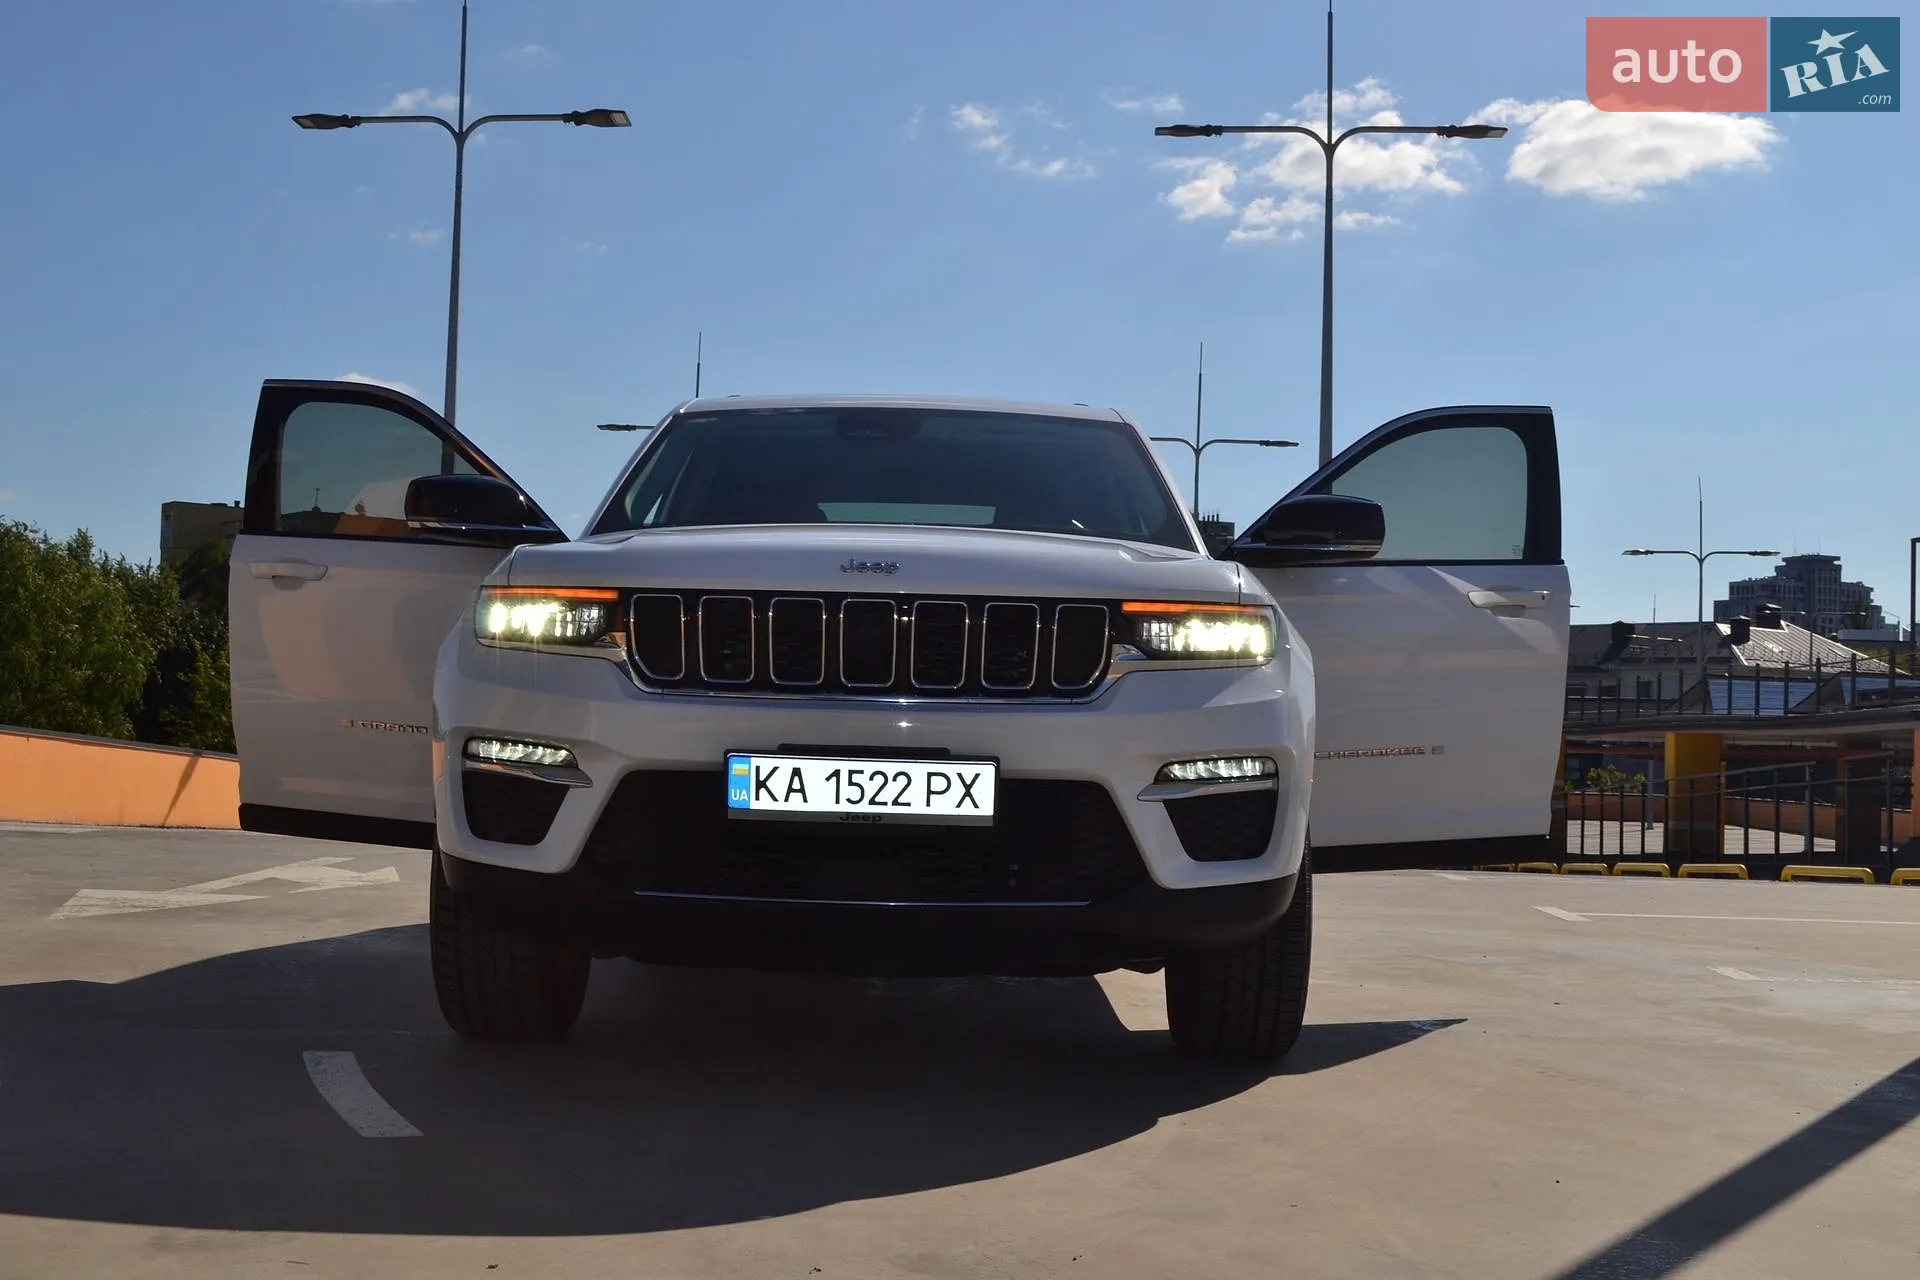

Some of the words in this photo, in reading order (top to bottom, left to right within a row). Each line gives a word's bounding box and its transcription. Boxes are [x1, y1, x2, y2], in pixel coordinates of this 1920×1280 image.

[840, 558, 900, 576] Jeep
[359, 720, 429, 735] GRAND
[1314, 746, 1425, 761] CHEROKEE
[731, 789, 749, 801] UA
[754, 765, 809, 804] KA
[824, 768, 913, 807] 1522
[925, 771, 981, 810] PX
[839, 812, 882, 824] Jeep
